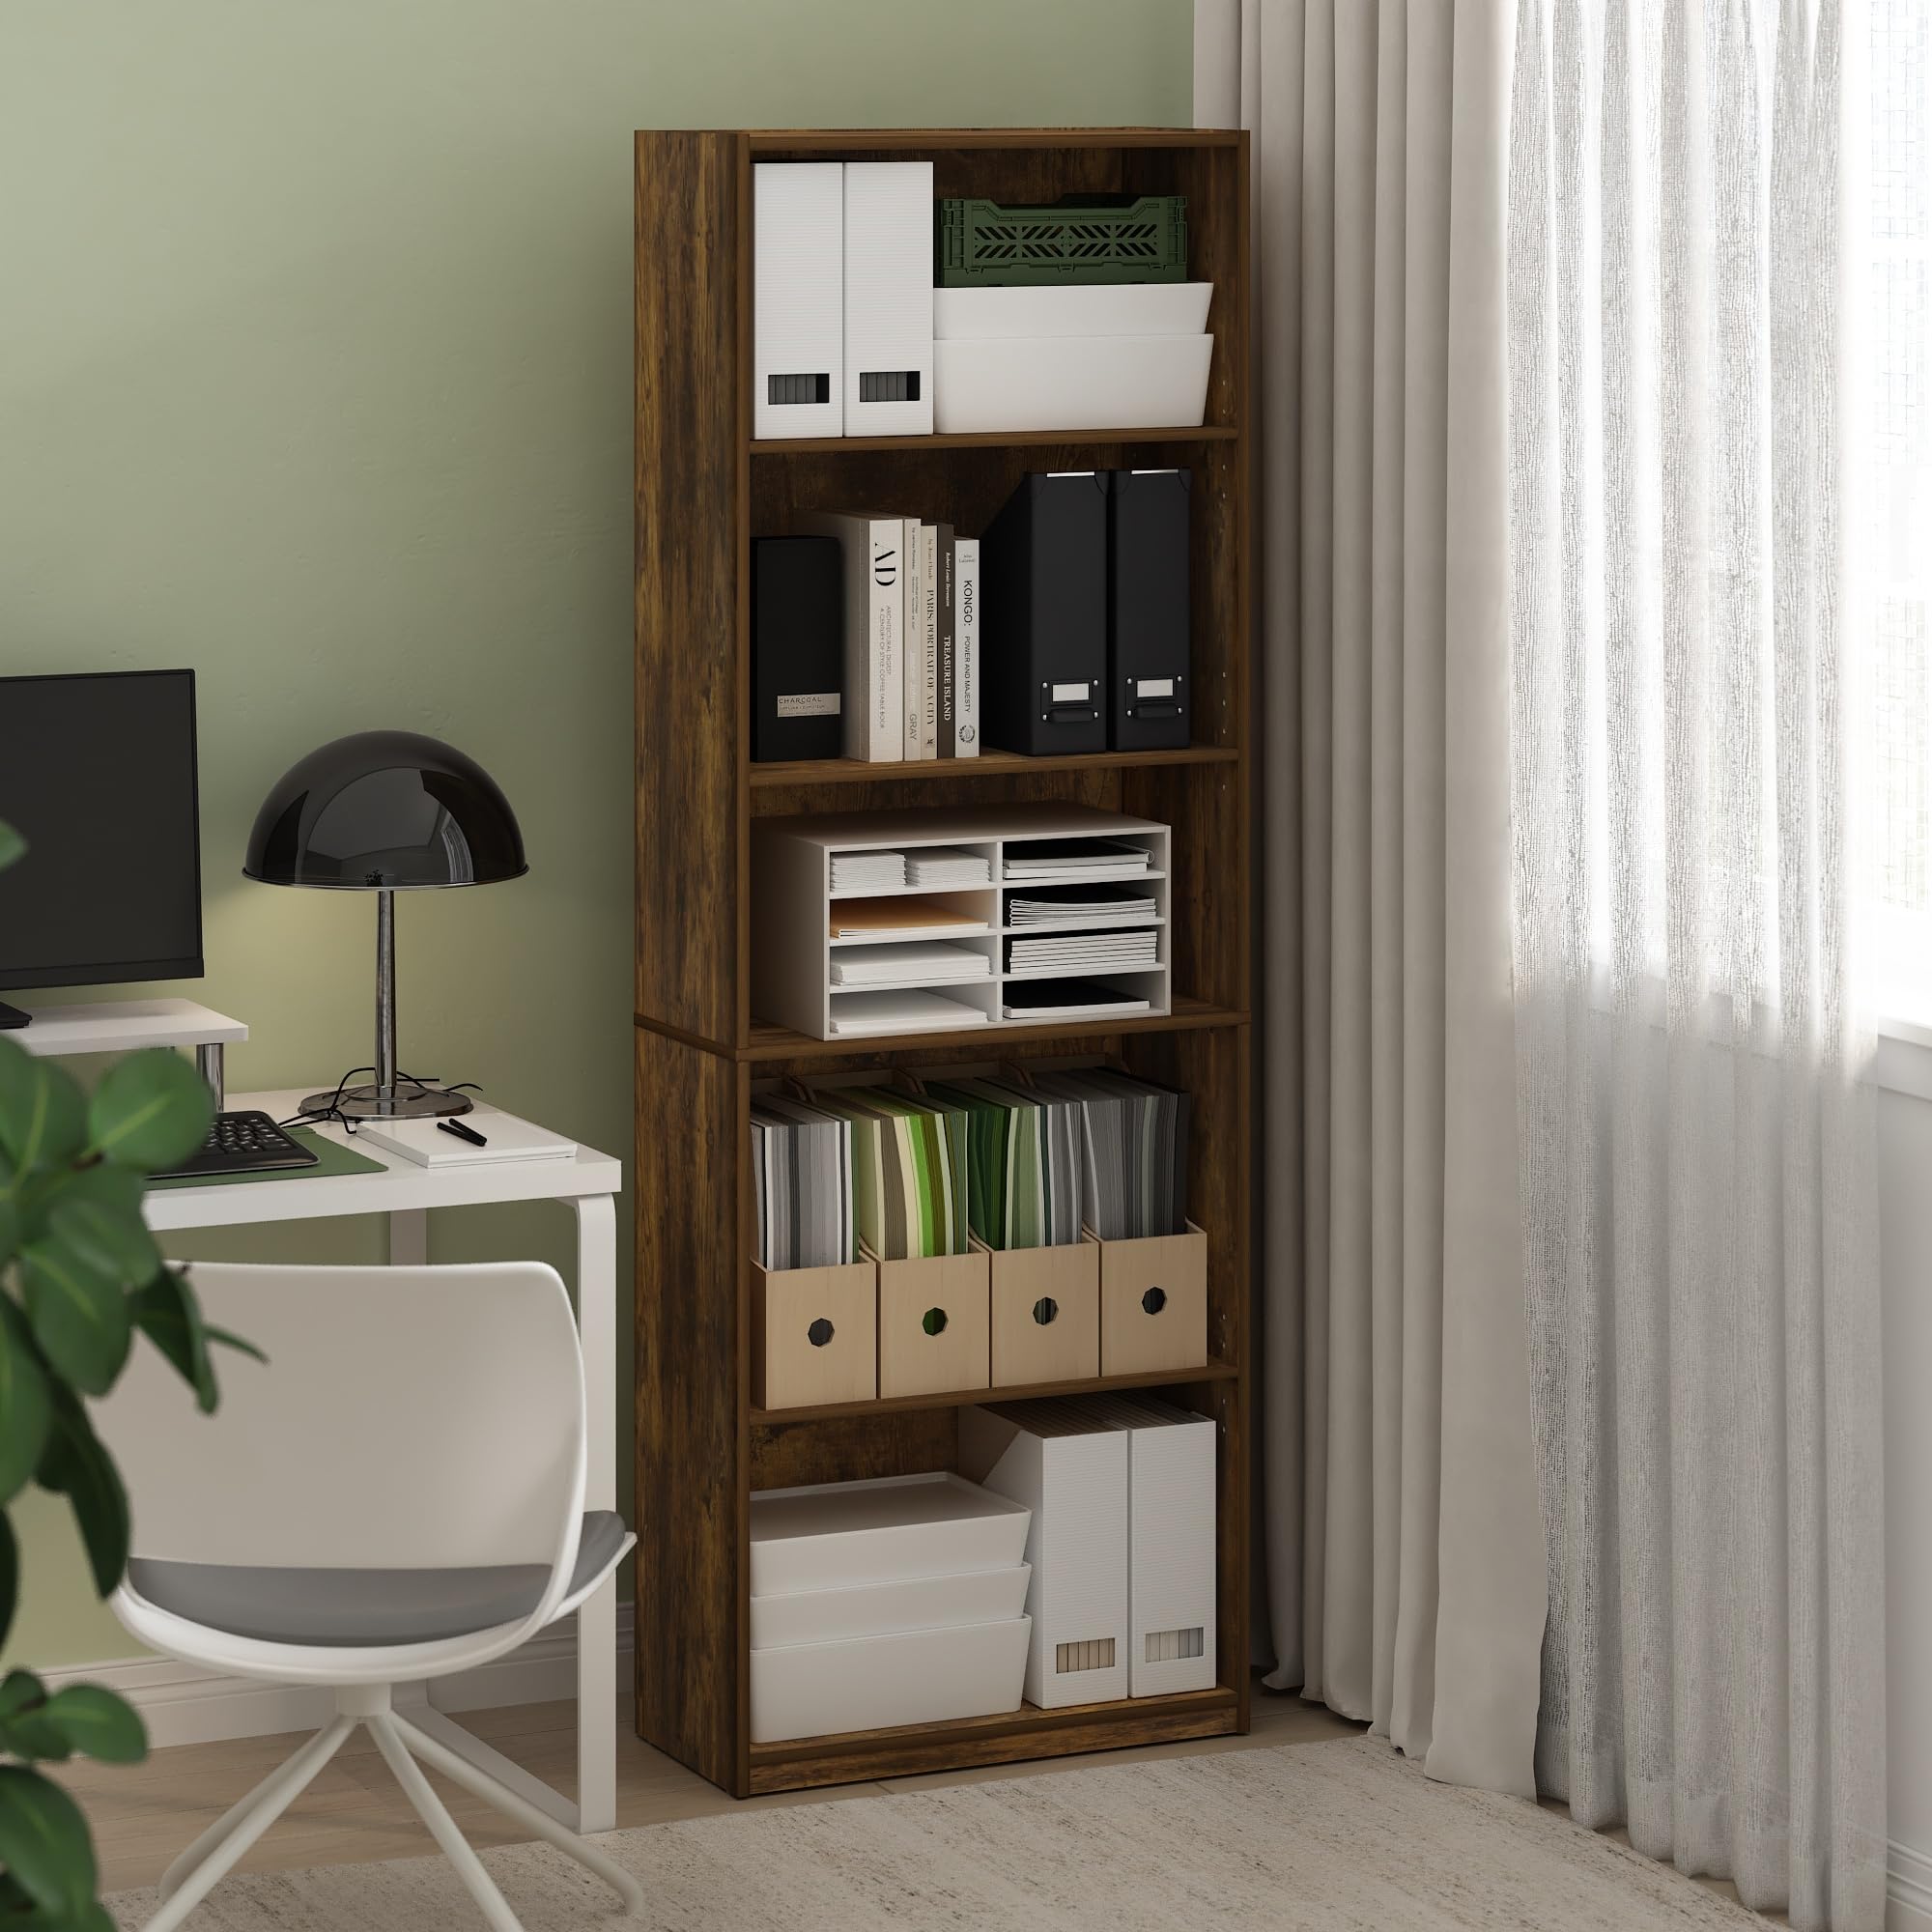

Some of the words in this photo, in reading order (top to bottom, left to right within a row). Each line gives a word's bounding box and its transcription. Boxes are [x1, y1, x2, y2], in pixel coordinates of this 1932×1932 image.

[874, 542, 896, 587] AD
[963, 580, 973, 626] KONGO:
[943, 635, 952, 684] TREASURE
[926, 677, 934, 690] OF
[943, 686, 952, 721] ISLAND
